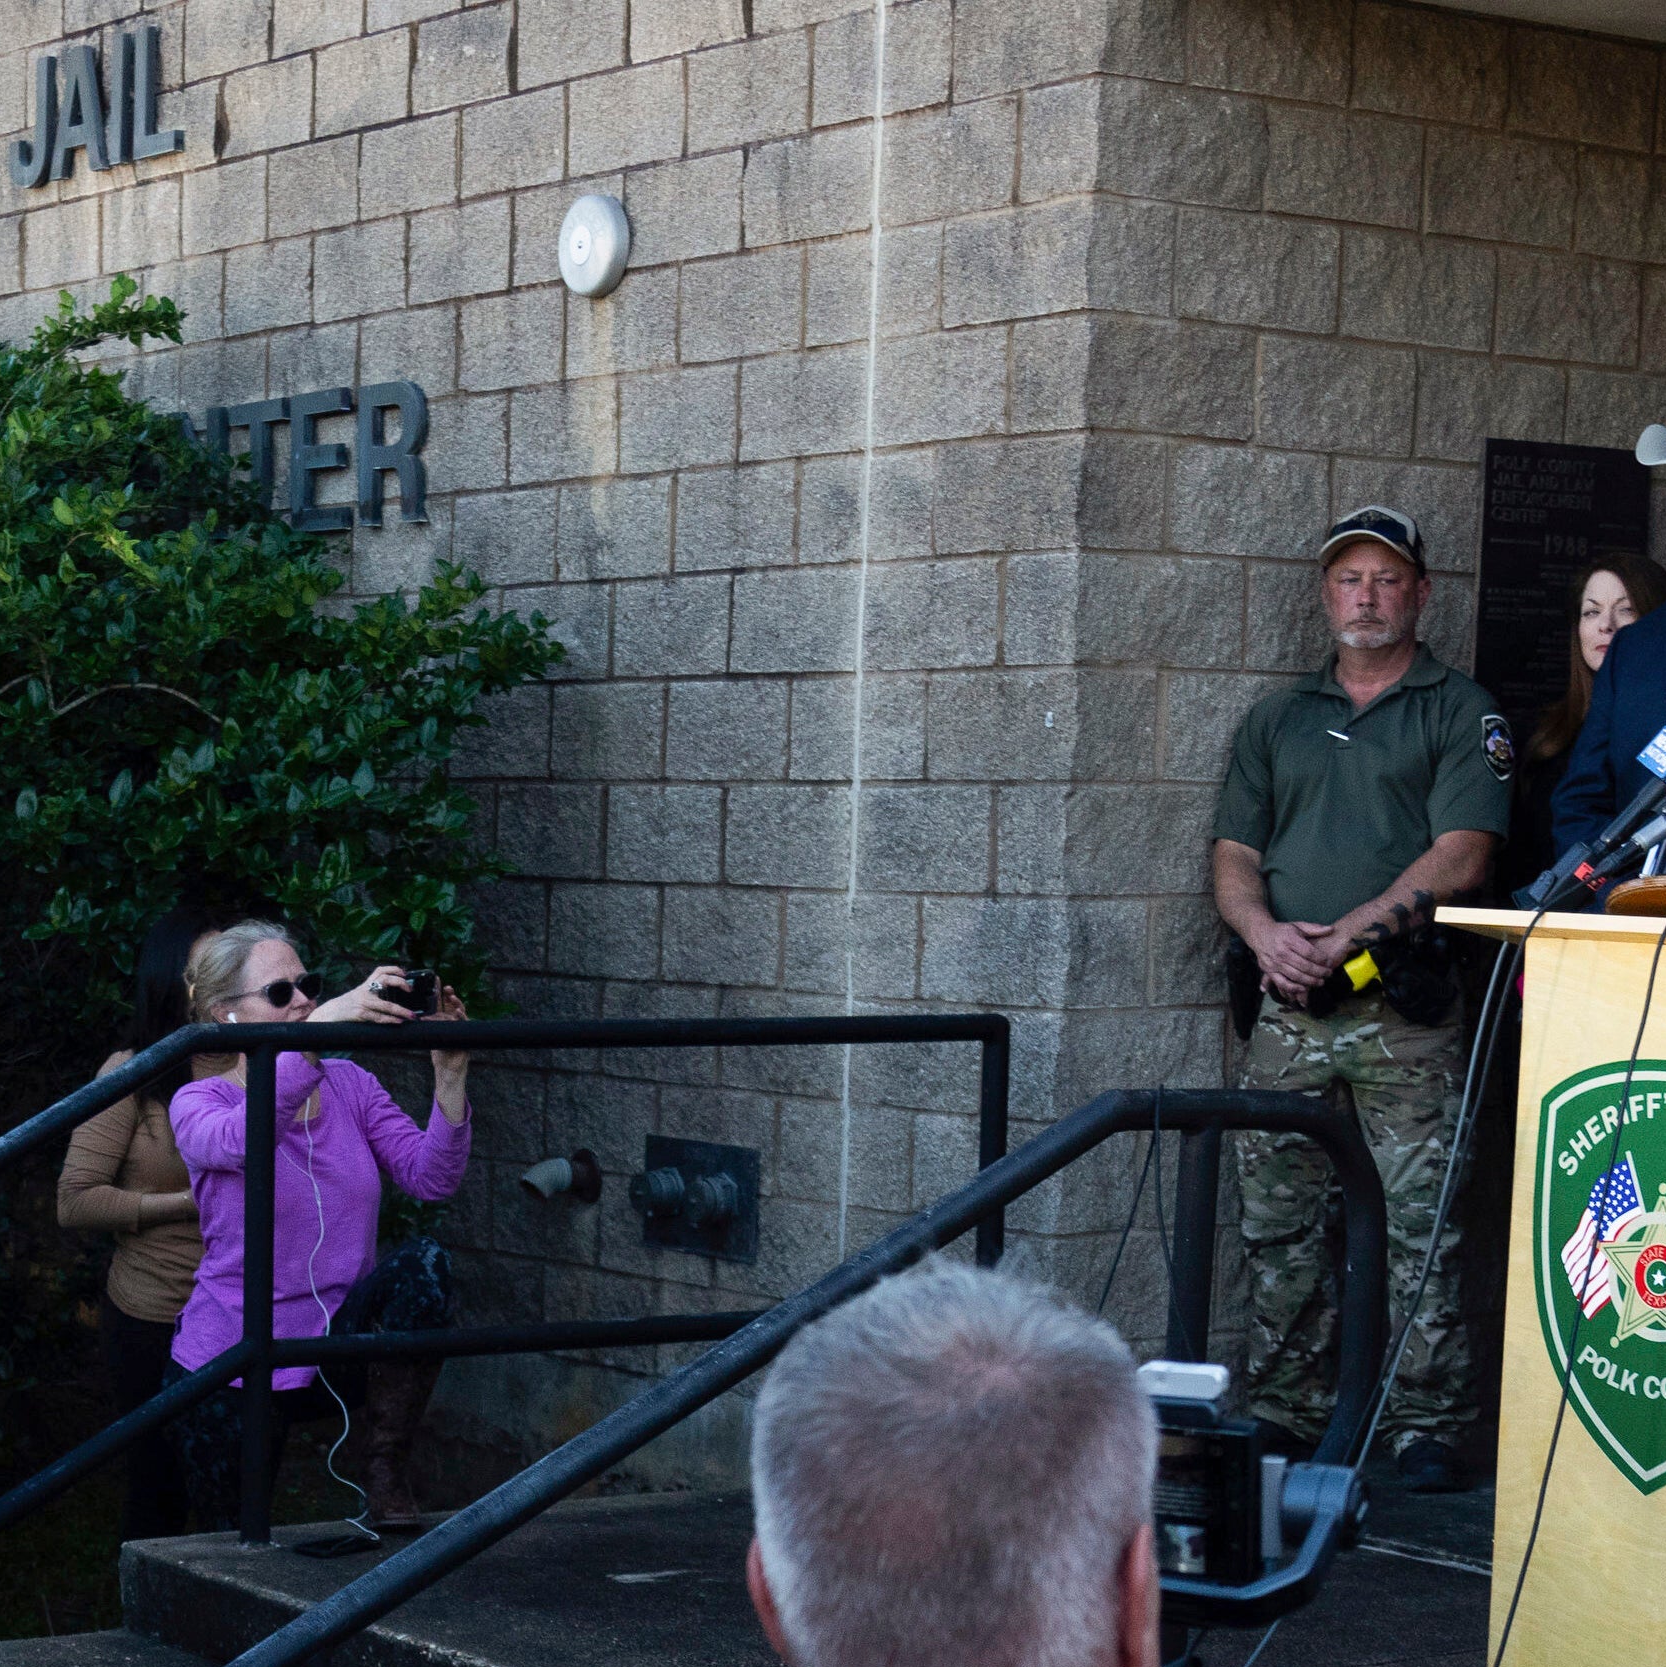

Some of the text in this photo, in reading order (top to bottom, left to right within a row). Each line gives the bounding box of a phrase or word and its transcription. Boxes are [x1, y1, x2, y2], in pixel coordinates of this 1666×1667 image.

[9, 25, 185, 188] JAIL
[1530, 474, 1560, 490] AND
[1639, 1246, 1665, 1267] STATE
[1577, 1344, 1639, 1396] POLK
